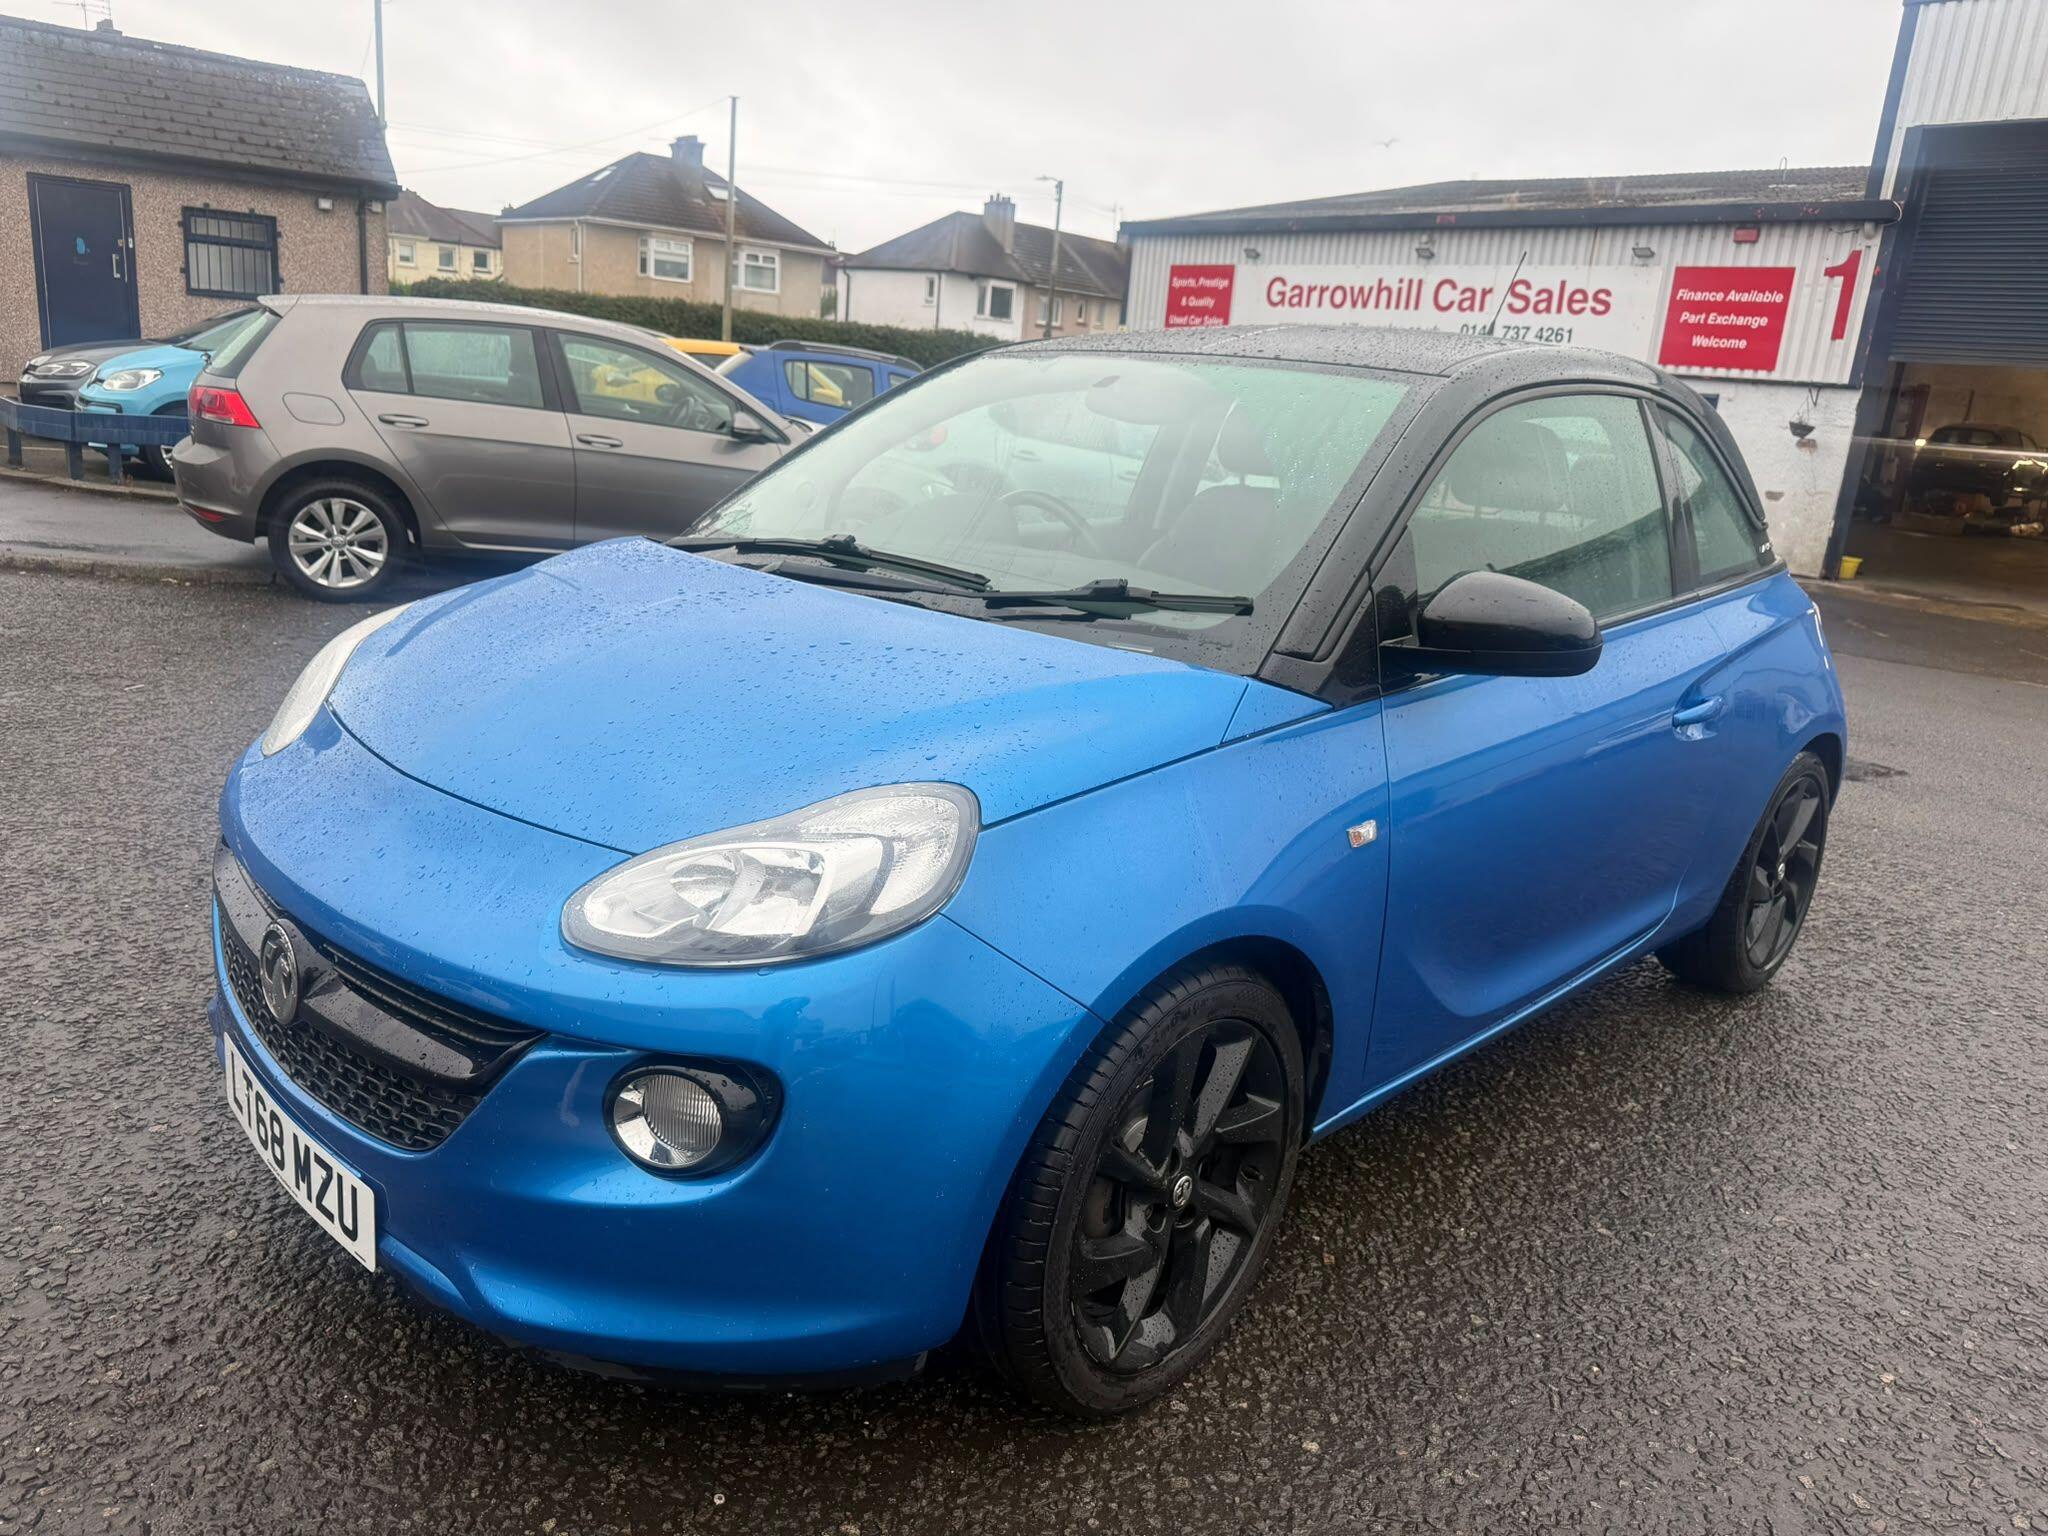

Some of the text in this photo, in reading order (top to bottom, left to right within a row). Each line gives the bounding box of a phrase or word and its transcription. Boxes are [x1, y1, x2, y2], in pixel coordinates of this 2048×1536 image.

[1188, 296, 1215, 308] Quality
[1266, 276, 1612, 316] Garrowhill Car Sales
[1677, 289, 1784, 303] Finance Available
[1824, 250, 1862, 340] 1
[1168, 315, 1224, 327] Used Car Sales
[1680, 311, 1768, 328] Part Exchange
[1460, 324, 1573, 343] 014 737 4261
[1692, 335, 1747, 349] Welcome
[231, 1051, 285, 1171] LT68
[293, 1132, 358, 1242] MZU
